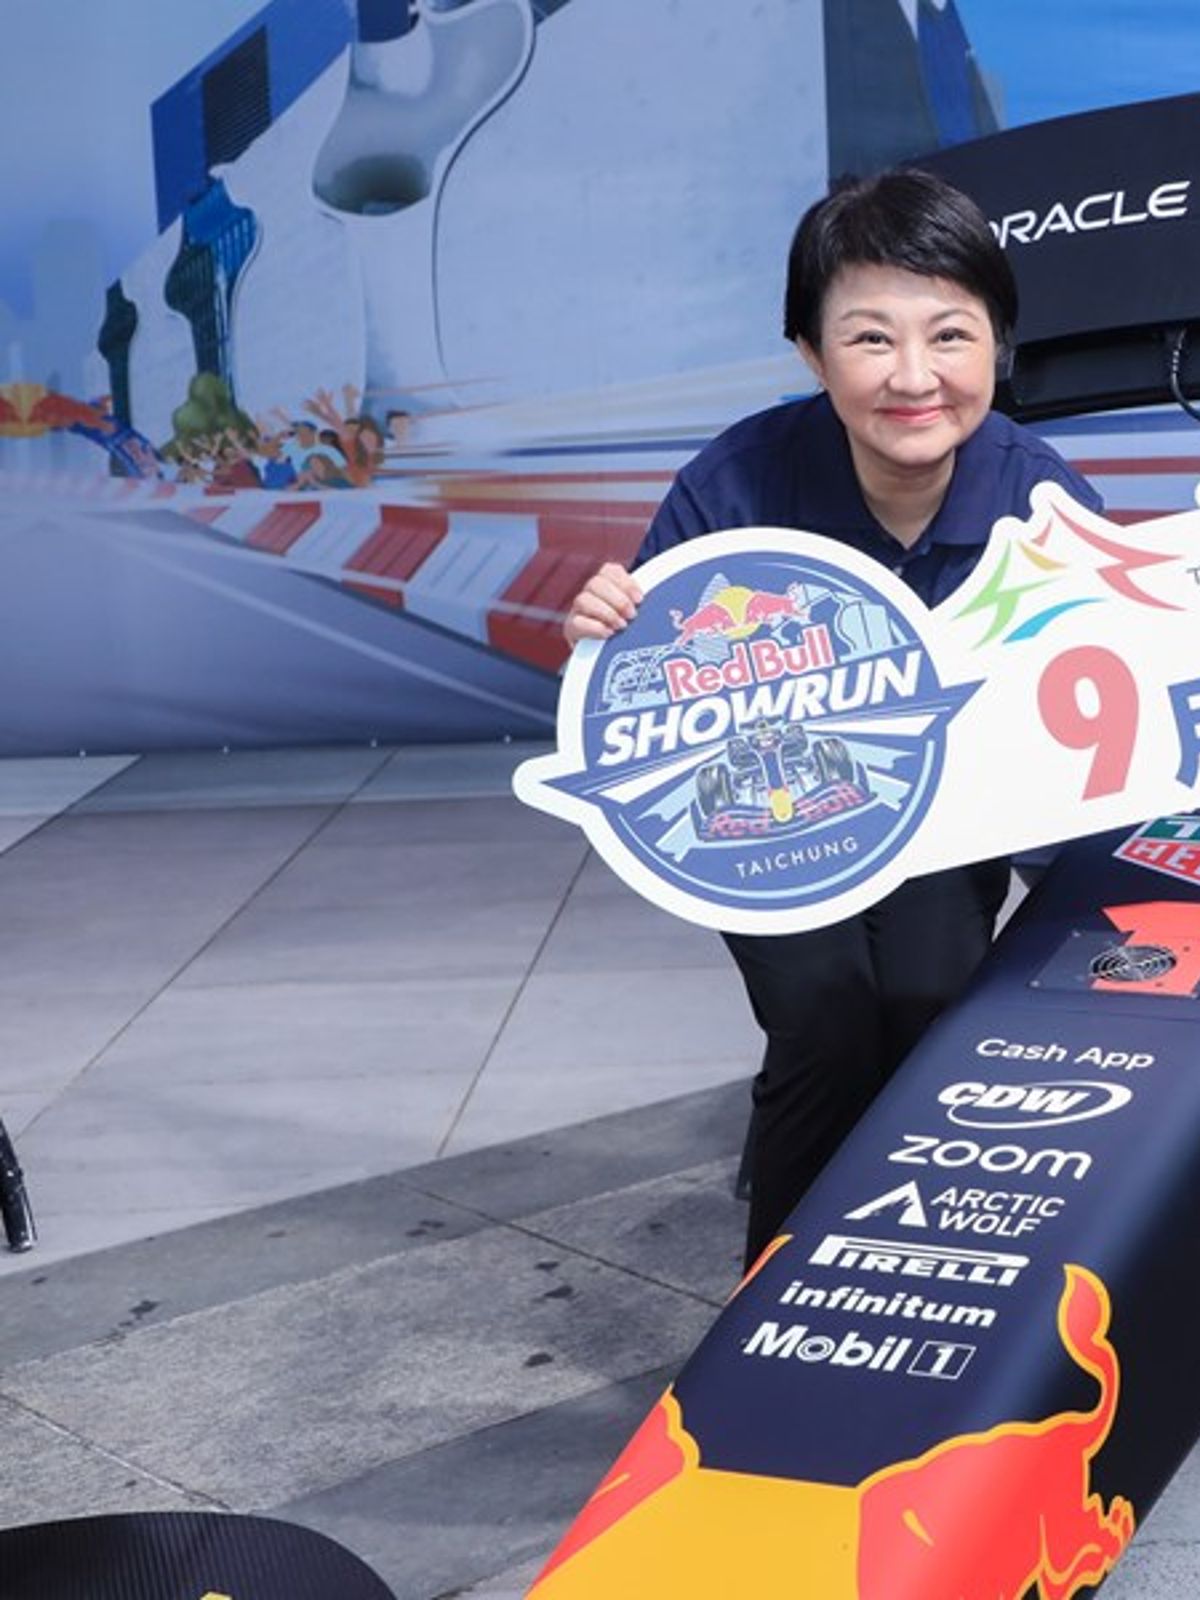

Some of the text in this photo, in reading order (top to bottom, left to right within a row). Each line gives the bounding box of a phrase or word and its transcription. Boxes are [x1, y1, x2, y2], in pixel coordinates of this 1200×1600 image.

[988, 180, 1191, 249] RACLE
[665, 623, 836, 702] Red Bull
[598, 650, 922, 766] SHOWRUN
[735, 836, 859, 880] TAICHUNG
[976, 1038, 1157, 1071] Cash App
[887, 1134, 1093, 1181] zoom
[930, 1186, 1067, 1218] ARCTIC
[938, 1210, 1042, 1239] WOLF
[808, 1233, 1031, 1287] PIRELLI
[779, 1280, 998, 1328] infinitum
[743, 1321, 914, 1372] Mobil
